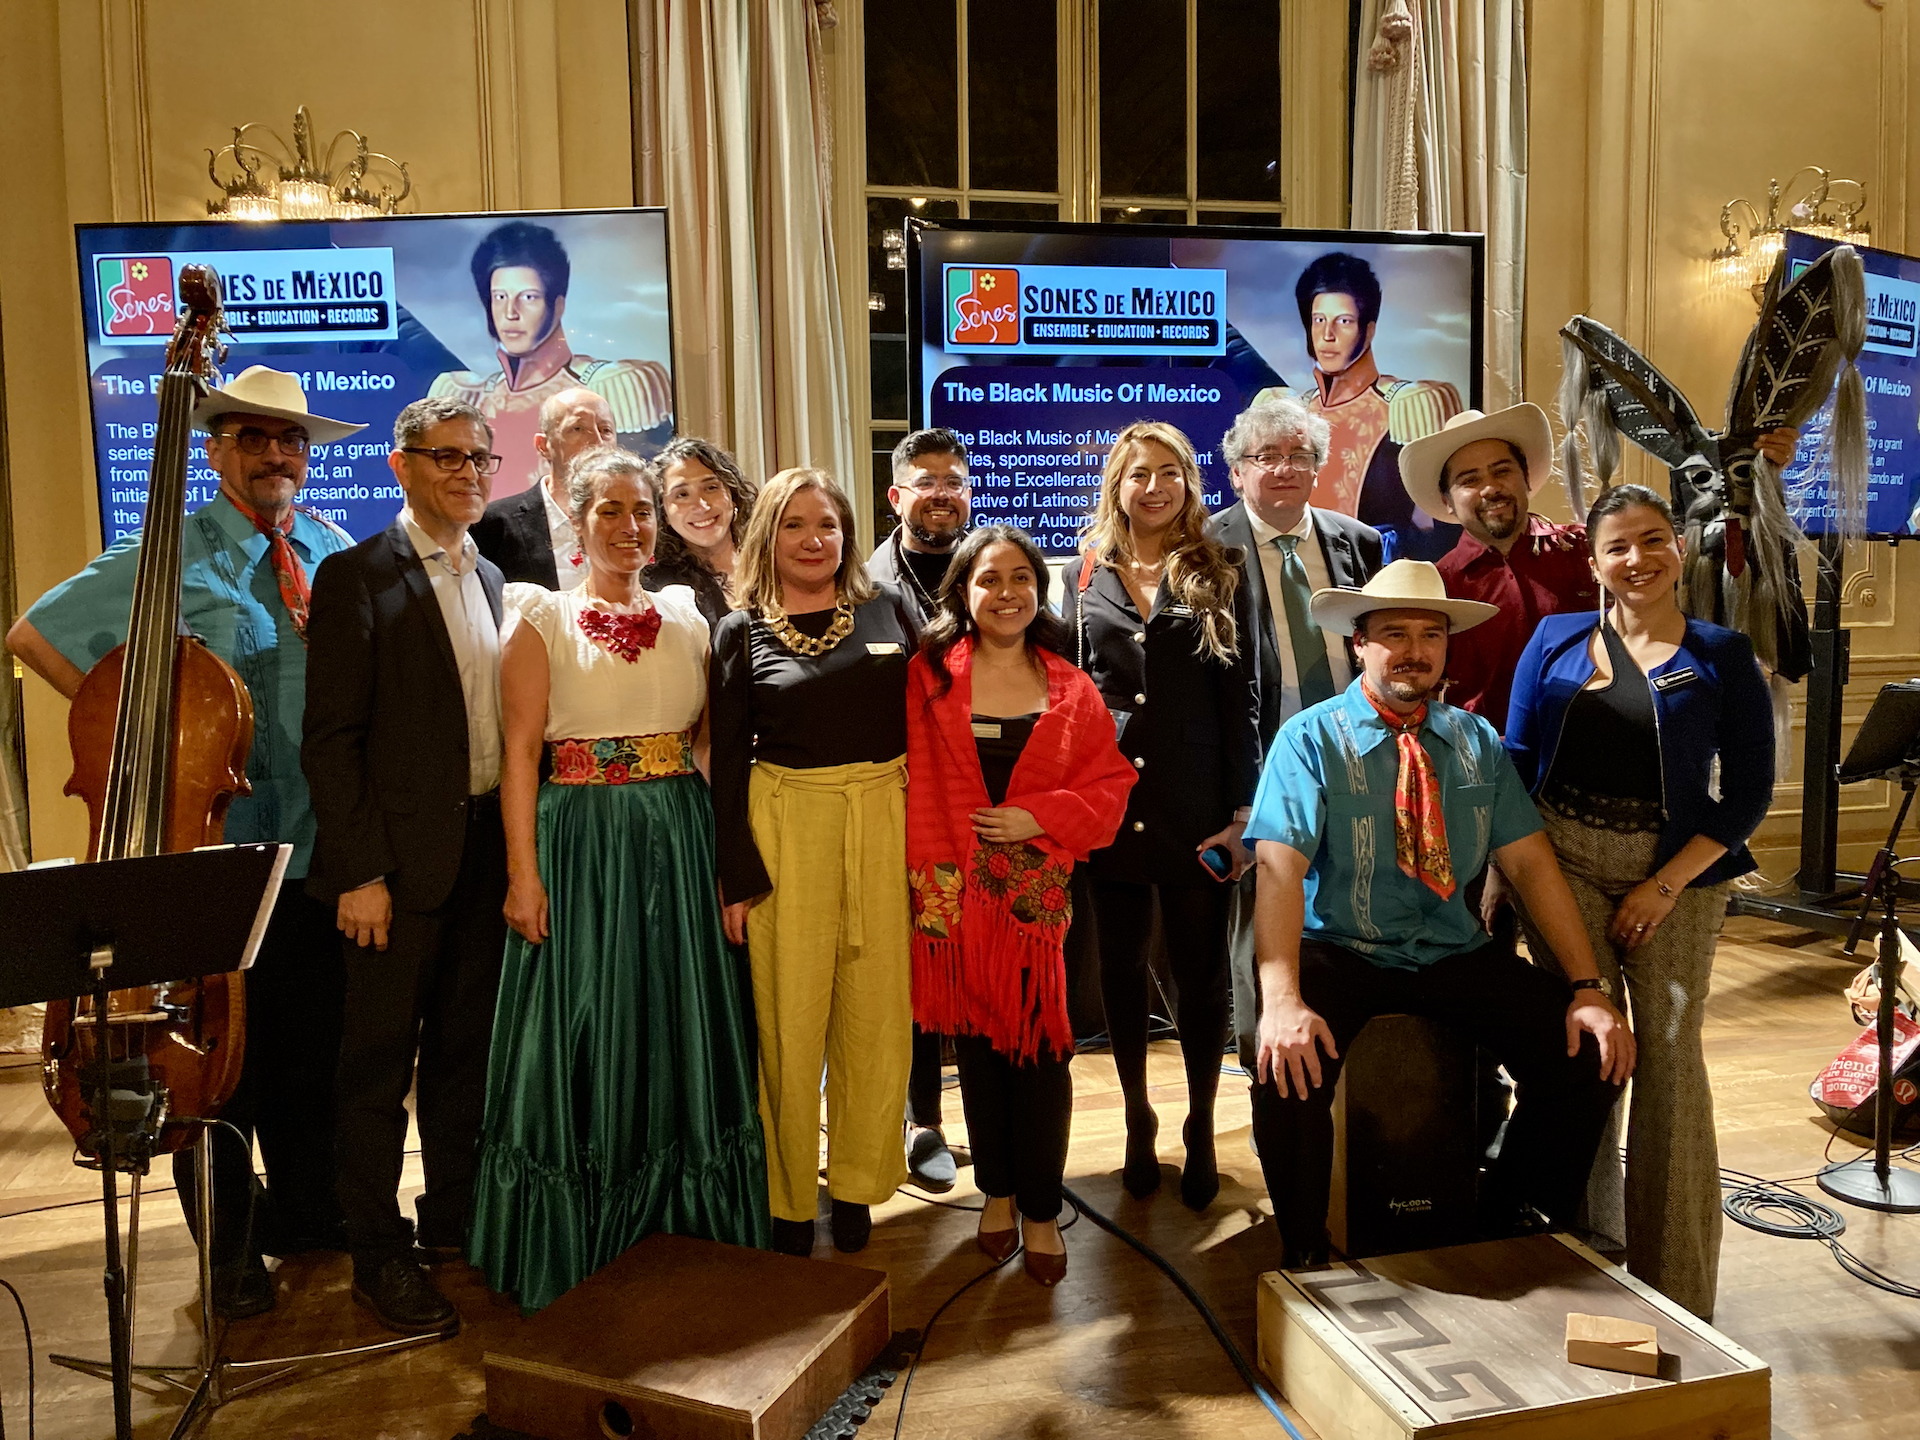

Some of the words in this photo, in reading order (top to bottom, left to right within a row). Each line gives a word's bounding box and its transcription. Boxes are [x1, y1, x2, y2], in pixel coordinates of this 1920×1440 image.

[264, 280, 285, 300] DE
[1024, 285, 1098, 315] SONES
[1104, 293, 1125, 315] DE
[257, 310, 319, 326] EDUCATION
[327, 307, 379, 324] RECORDS
[1033, 323, 1089, 339] ENSEMBLE
[1097, 324, 1154, 340] EDUCATION
[1162, 324, 1210, 340] RECORDS
[102, 374, 145, 395] The
[316, 370, 396, 391] Mexico
[1865, 376, 1877, 393] Of
[1878, 378, 1912, 398] Mexico
[943, 382, 984, 402] The
[989, 383, 1047, 402] Black
[1053, 384, 1113, 403] Music
[1118, 383, 1143, 403] Of
[1148, 384, 1221, 403] Mexico
[106, 423, 138, 439] The
[979, 429, 1022, 445] Black
[1026, 429, 1072, 445] Music
[1075, 430, 1092, 445] of
[333, 444, 344, 457] a
[348, 440, 391, 460] grant
[1878, 439, 1884, 449] a
[1884, 439, 1903, 451] grant
[999, 451, 1081, 470] sponsored
[1085, 452, 1099, 466] in
[1796, 449, 1809, 462] the
[1876, 457, 1886, 467] an
[110, 467, 149, 483] from
[332, 465, 353, 478] an
[985, 471, 1011, 487] the
[1890, 472, 1904, 485] and
[373, 484, 404, 499] and
[1013, 492, 1029, 508] of
[1033, 492, 1089, 507] Latinos
[113, 509, 141, 525] the
[975, 513, 1035, 528] Greater
[1843, 1070, 1875, 1081] more
[1826, 1082, 1867, 1097] money
[1389, 1197, 1433, 1216] tycoon
